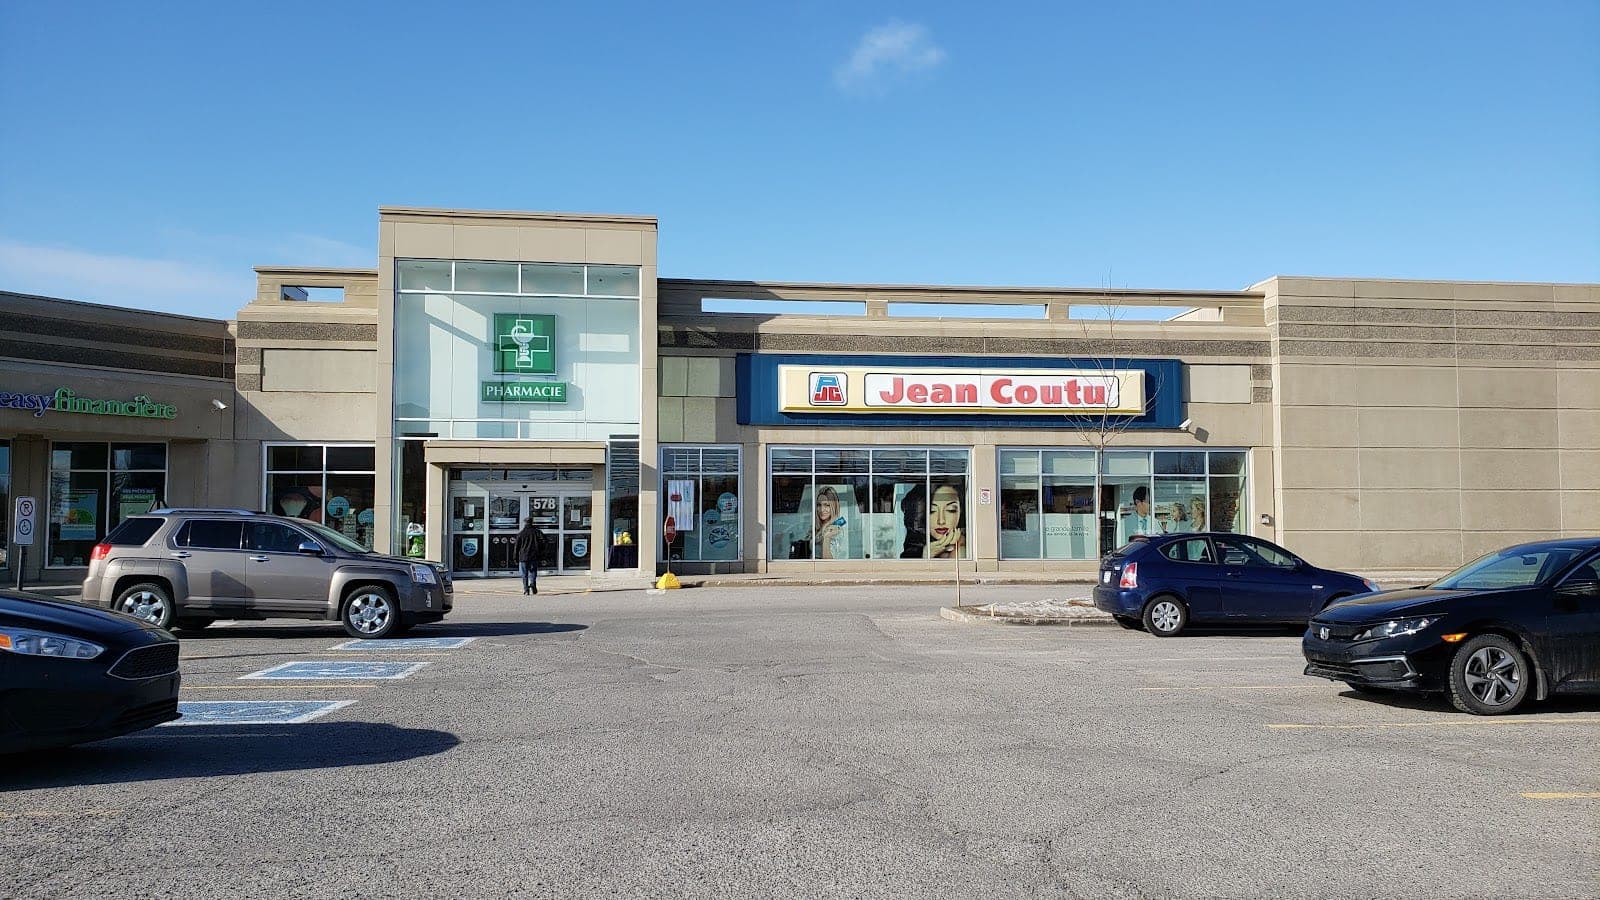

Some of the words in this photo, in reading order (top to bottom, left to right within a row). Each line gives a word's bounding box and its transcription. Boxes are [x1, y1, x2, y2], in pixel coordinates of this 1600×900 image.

[486, 386, 562, 398] PHARMACIE
[879, 377, 978, 404] Jean
[990, 378, 1106, 405] Coutu
[533, 498, 556, 510] 578
